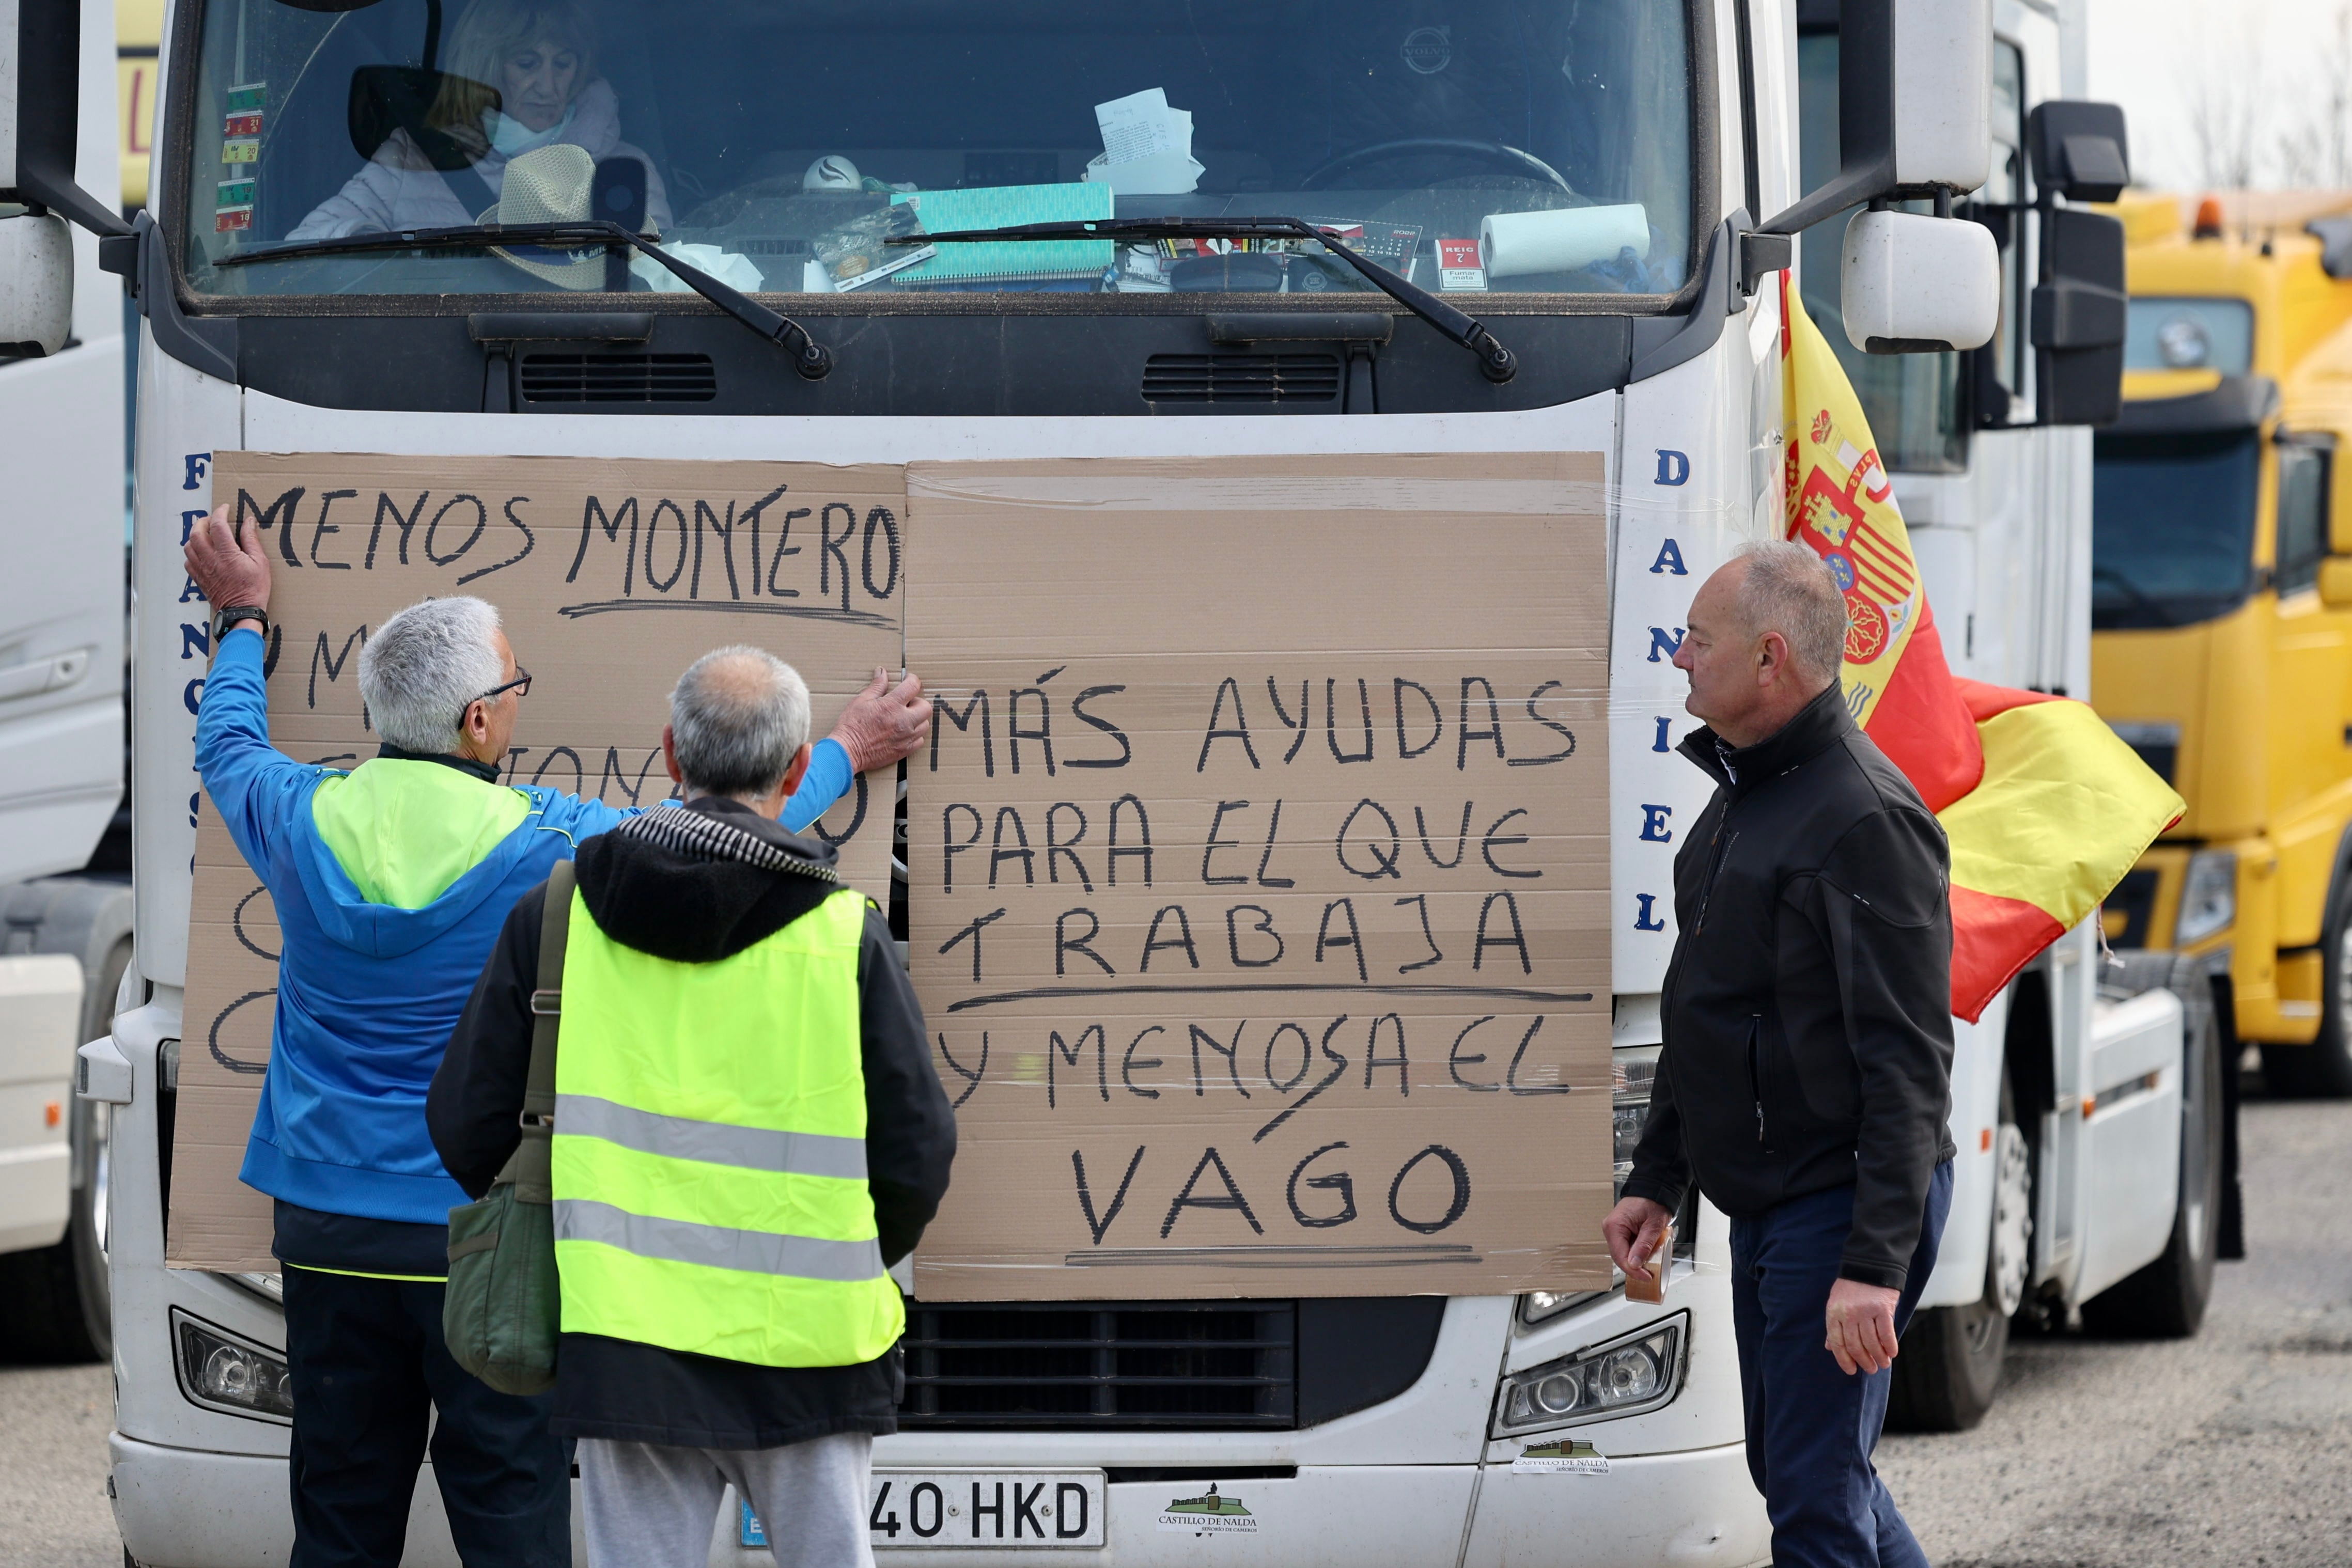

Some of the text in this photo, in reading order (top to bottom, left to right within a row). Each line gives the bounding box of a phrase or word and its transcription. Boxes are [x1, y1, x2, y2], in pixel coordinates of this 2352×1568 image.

[235, 483, 901, 613] MENOS MONTERO
[929, 666, 1577, 777] MÁS AYUDAS
[943, 793, 1154, 894] PARA
[1201, 798, 1295, 888] EL
[1336, 797, 1543, 879] QUE
[939, 889, 1533, 983] TRABAJA
[938, 1029, 988, 1110] Y
[1448, 1015, 1571, 1096] EL
[1071, 1140, 1471, 1246] VAGO
[972, 1482, 1088, 1538] HKD
[1159, 1516, 1205, 1525] CASTILLO
[1223, 1518, 1257, 1527] NALDA
